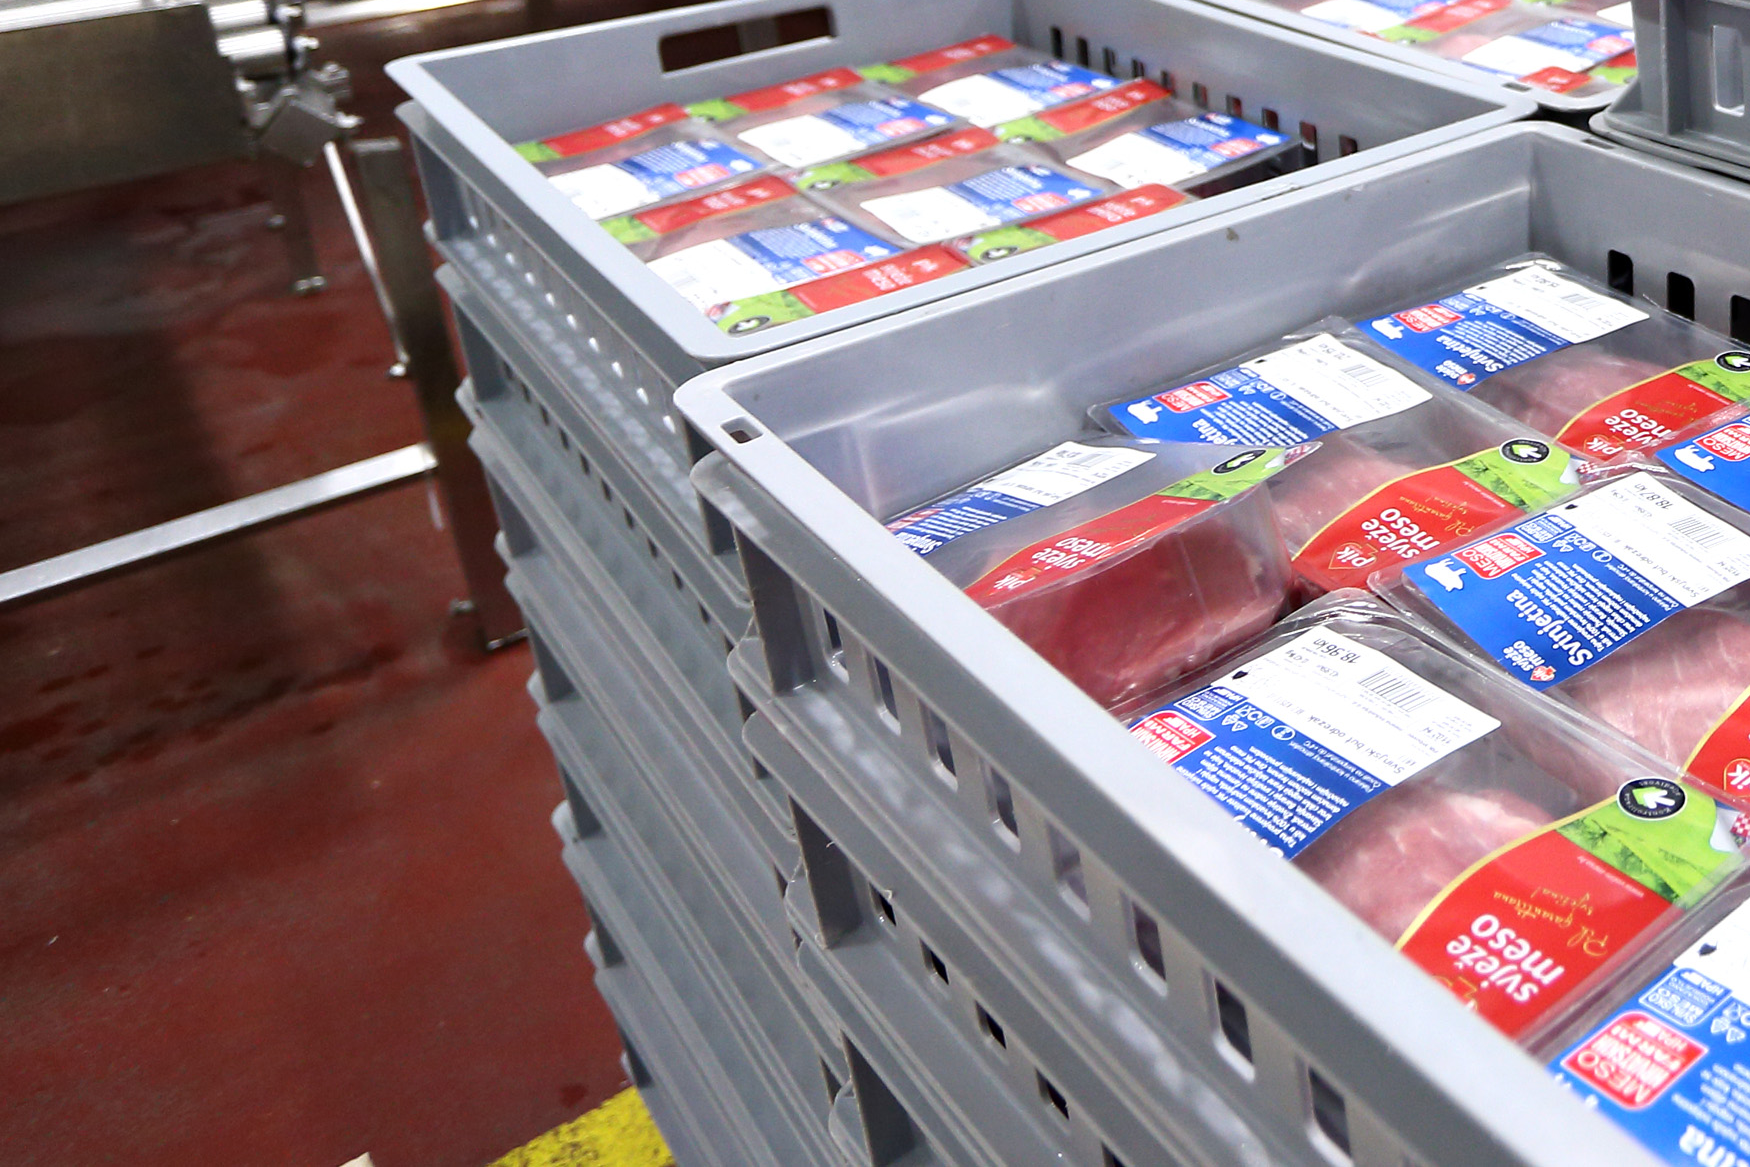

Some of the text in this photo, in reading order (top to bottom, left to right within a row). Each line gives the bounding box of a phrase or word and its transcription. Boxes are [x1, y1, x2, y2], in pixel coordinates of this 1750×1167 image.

[1436, 335, 1504, 372] Svinjetina
[1192, 418, 1239, 449] jetina
[1587, 438, 1624, 455] pik
[1703, 437, 1745, 459] MESO
[1361, 519, 1427, 558] svježe
[1371, 508, 1440, 550] meso
[1032, 548, 1097, 569] svježe
[1055, 537, 1117, 557] meso
[1337, 546, 1376, 567] pik
[1462, 549, 1501, 576] MESO
[994, 573, 1035, 590] pik
[1506, 589, 1593, 665] Svinjetina
[1503, 645, 1539, 671] svježe
[1510, 641, 1545, 666] meso
[1144, 720, 1191, 751] FARMI
[1308, 715, 1405, 774] Svinjski but odrezak
[1471, 914, 1564, 985] meso
[1447, 935, 1538, 1001] svježe
[1577, 1048, 1657, 1106] MESO
